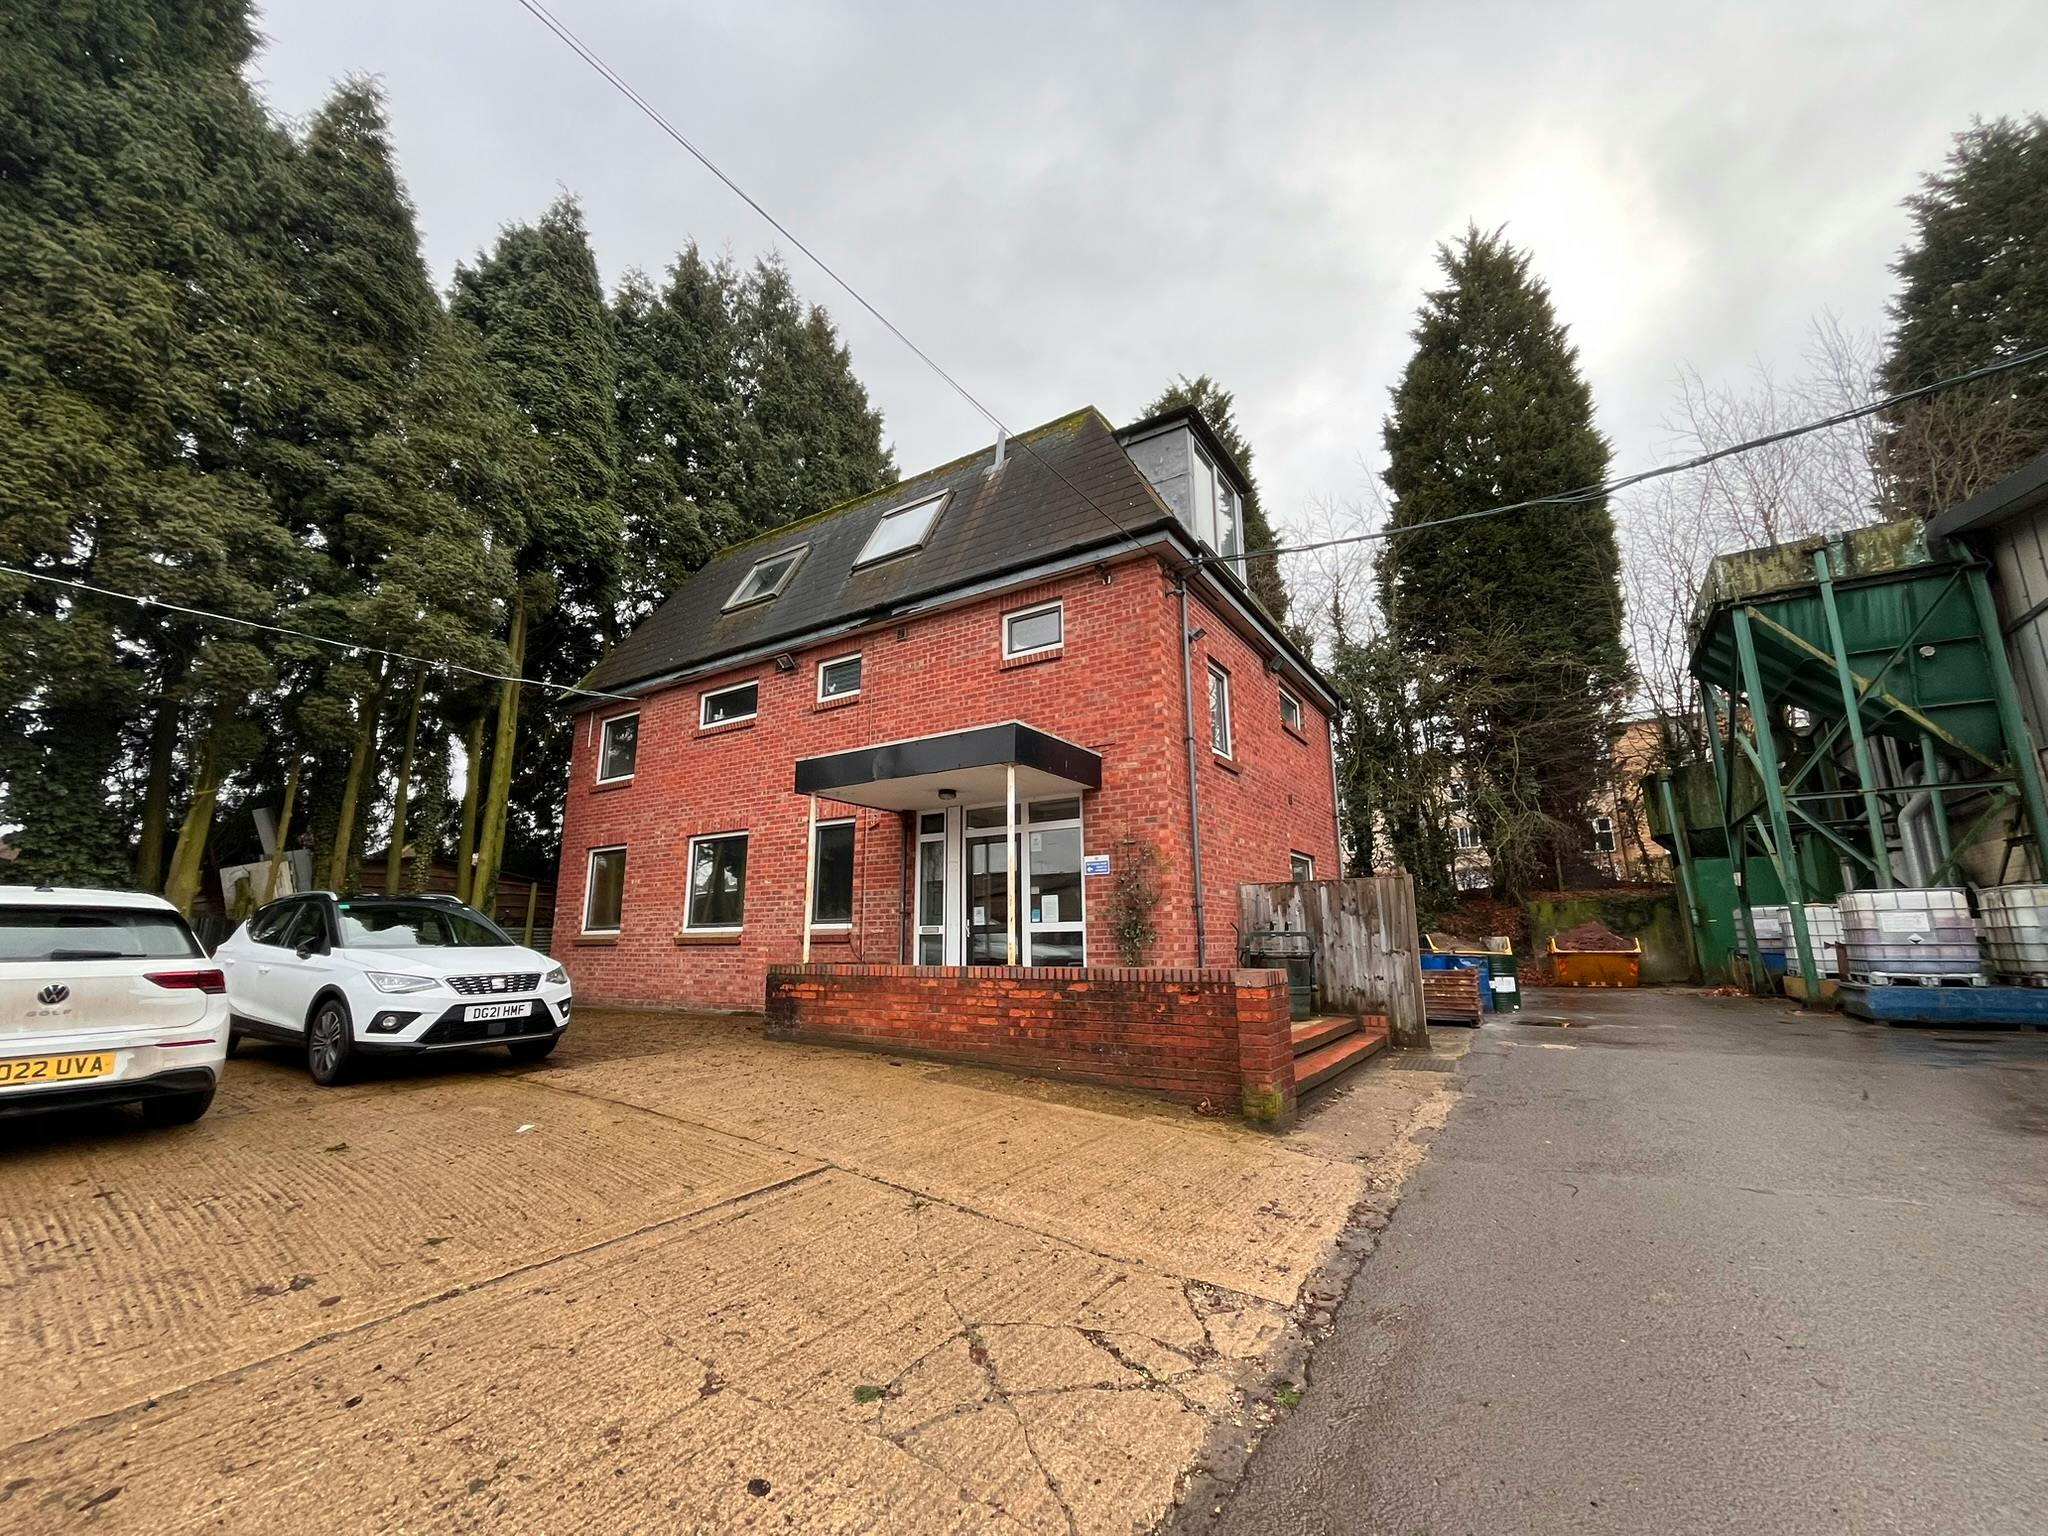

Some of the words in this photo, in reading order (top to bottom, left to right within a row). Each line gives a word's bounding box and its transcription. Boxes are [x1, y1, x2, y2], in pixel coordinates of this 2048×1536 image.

[26, 1008, 72, 1017] GOLF
[473, 1006, 501, 1019] DG21
[502, 1004, 525, 1017] HMF
[56, 1056, 103, 1075] UVA
